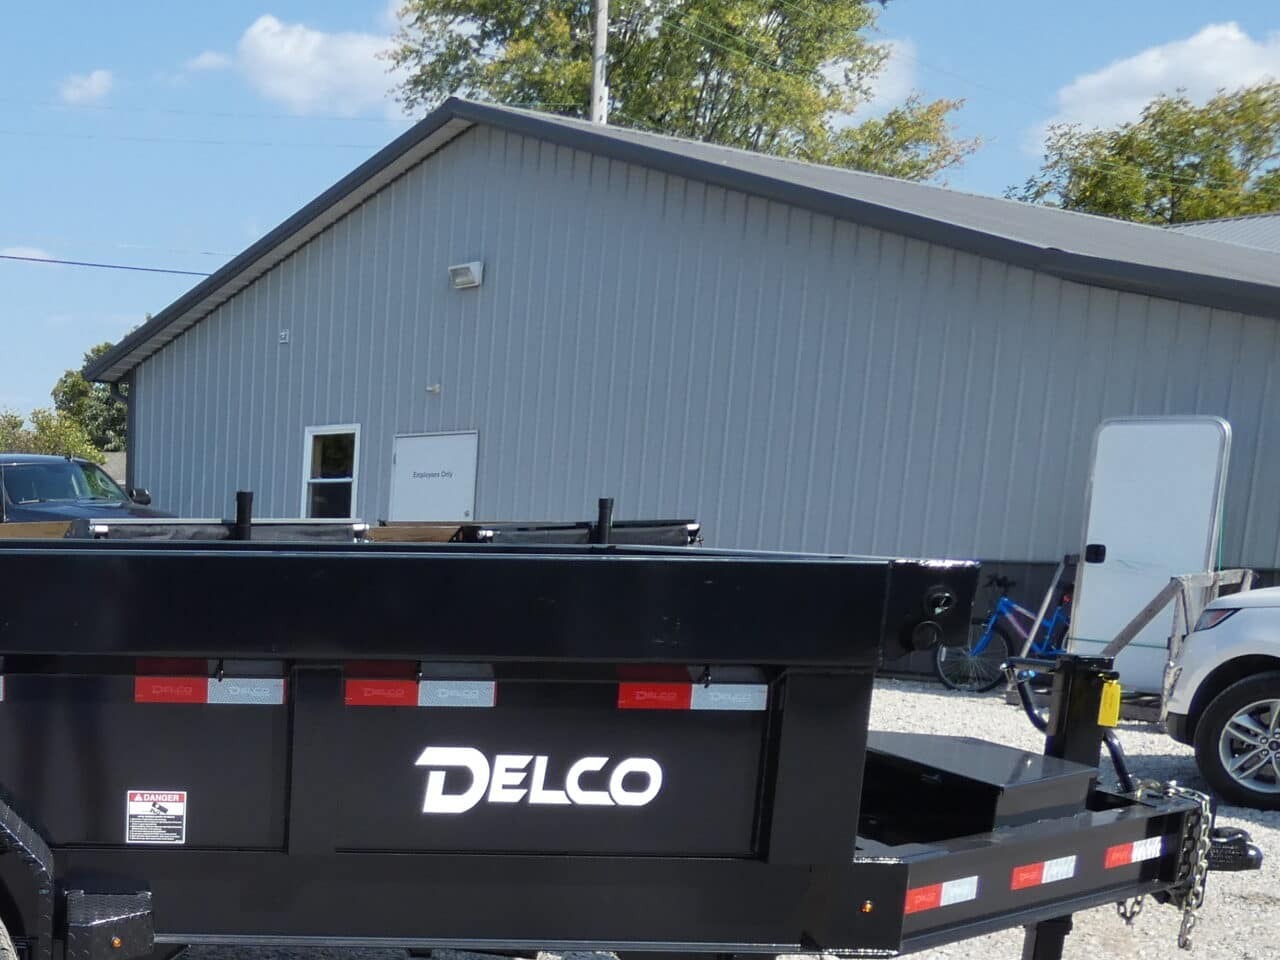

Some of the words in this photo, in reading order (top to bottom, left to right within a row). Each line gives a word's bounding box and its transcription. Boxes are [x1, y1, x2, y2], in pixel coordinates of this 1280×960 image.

[412, 471, 440, 479] Employees
[414, 746, 663, 814] DELCO
[143, 793, 179, 802] DANGER
